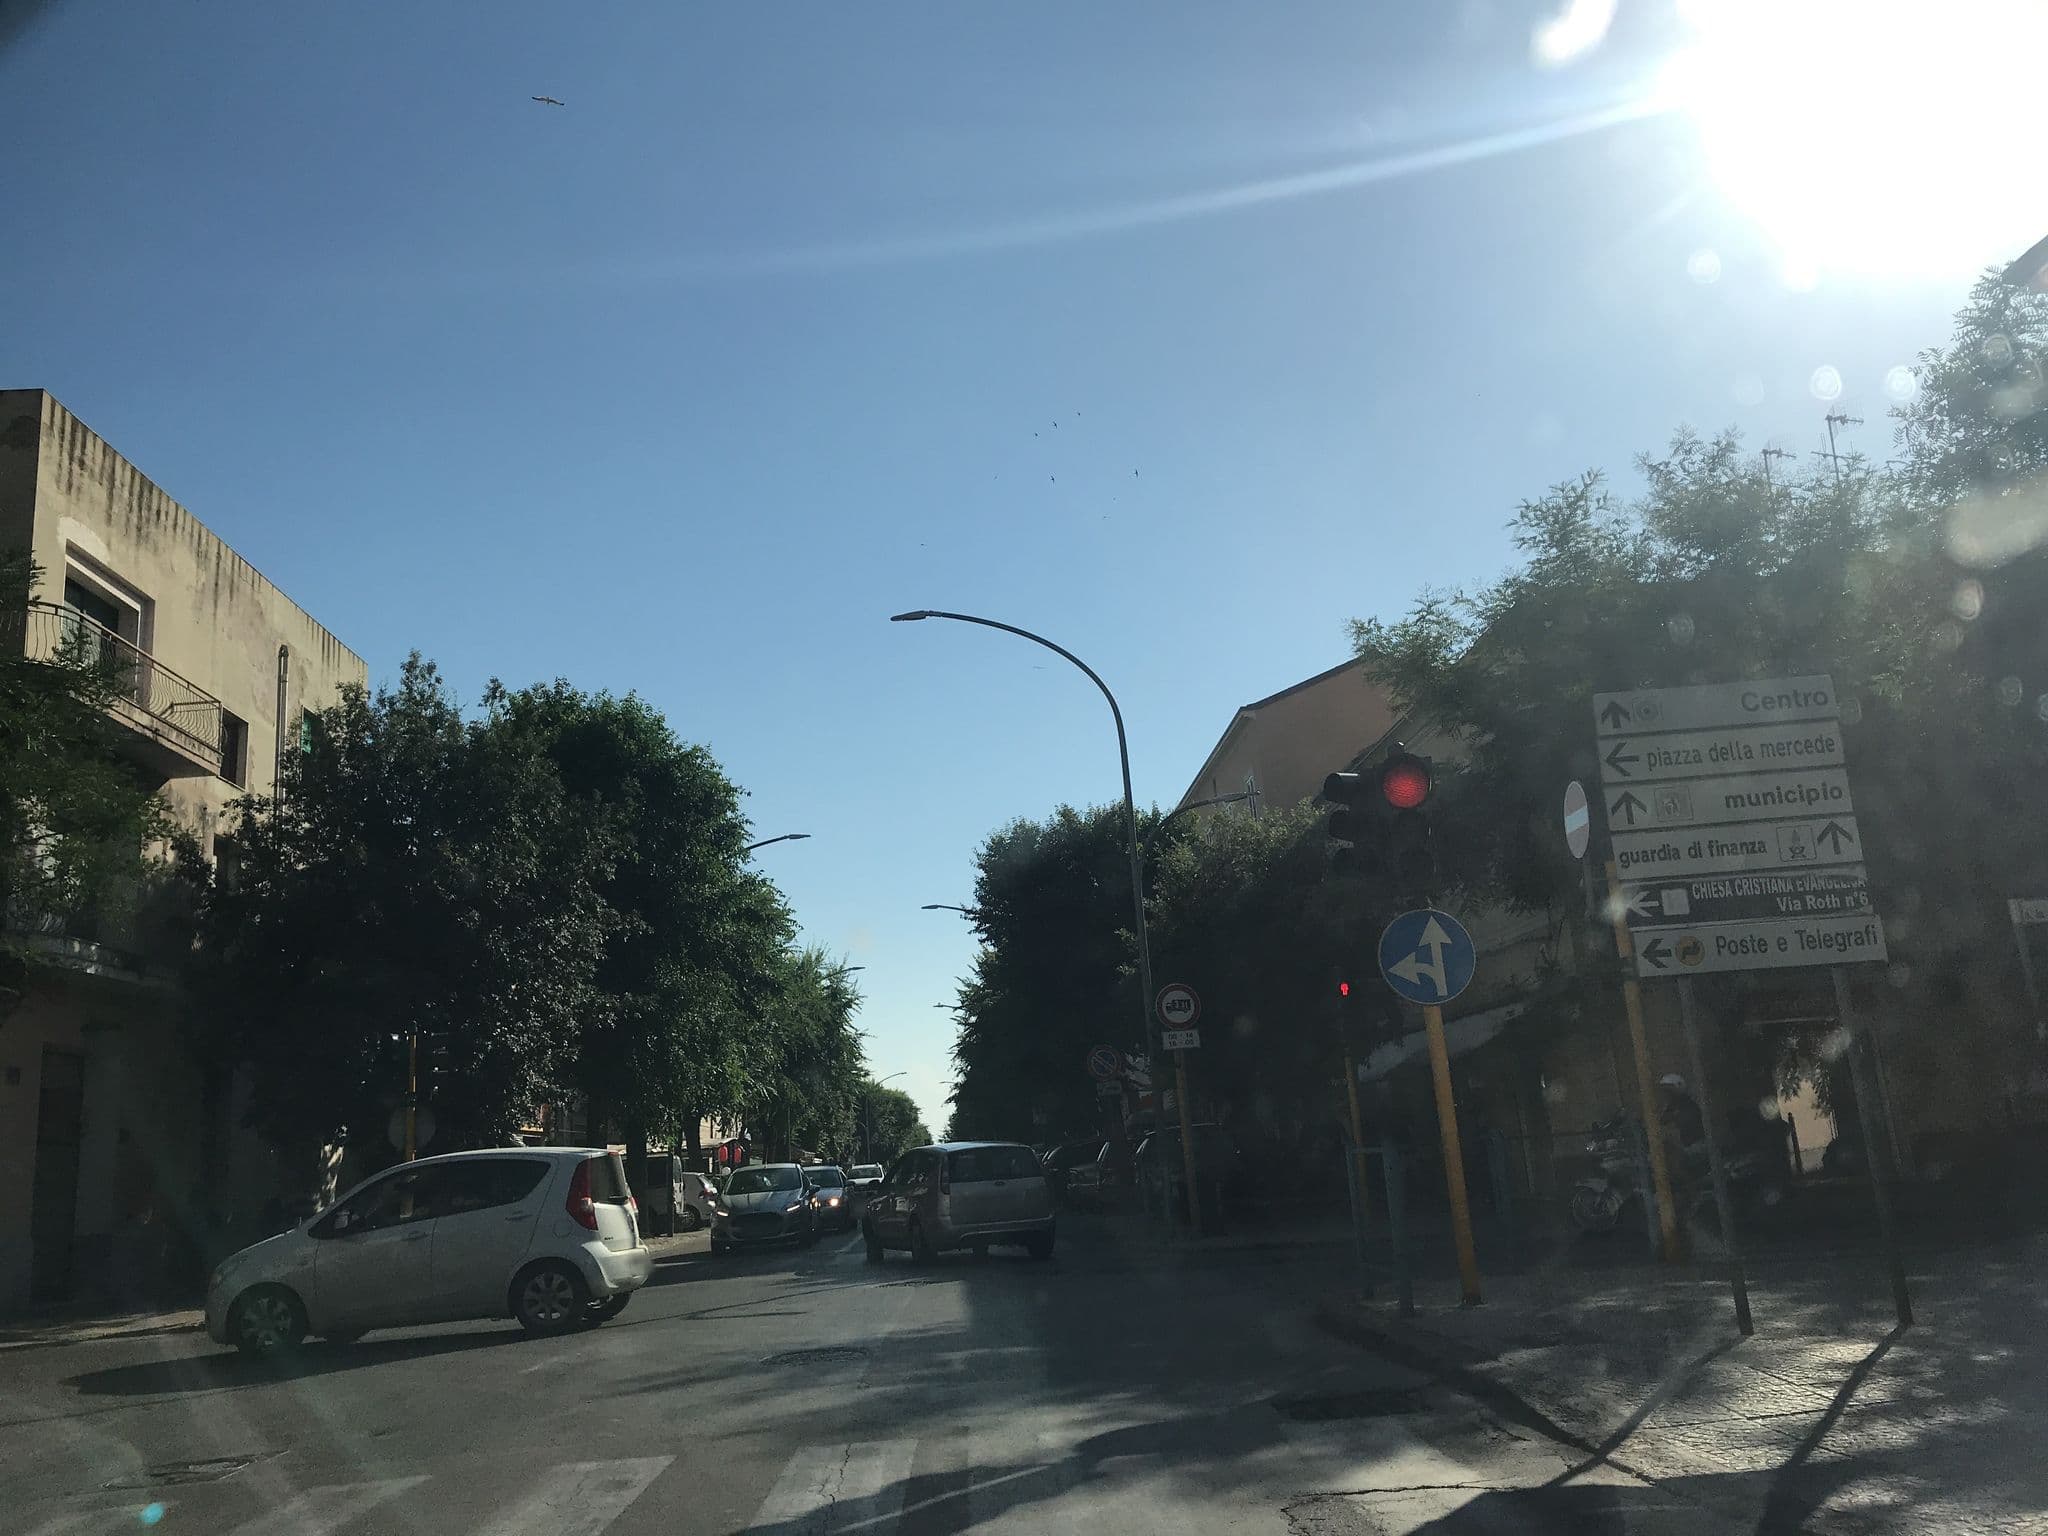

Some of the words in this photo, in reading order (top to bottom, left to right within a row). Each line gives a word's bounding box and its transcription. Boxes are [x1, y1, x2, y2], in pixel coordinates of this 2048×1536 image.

[1740, 689, 1829, 712] Centro
[1647, 747, 1703, 771] piazza
[1708, 740, 1754, 763] della
[1760, 733, 1836, 760] mercede
[1724, 781, 1844, 809] municipio
[1619, 844, 1681, 869] guardia
[1688, 840, 1703, 859] di
[1707, 837, 1768, 858] finanza
[1692, 879, 1734, 900] CHIESA
[1735, 876, 1794, 896] CRISTIANA
[1776, 895, 1802, 912] Via
[1806, 893, 1842, 910] Roth
[1715, 933, 1769, 956] Poste
[1777, 935, 1788, 952] e
[1794, 923, 1879, 953] Telegrafi
